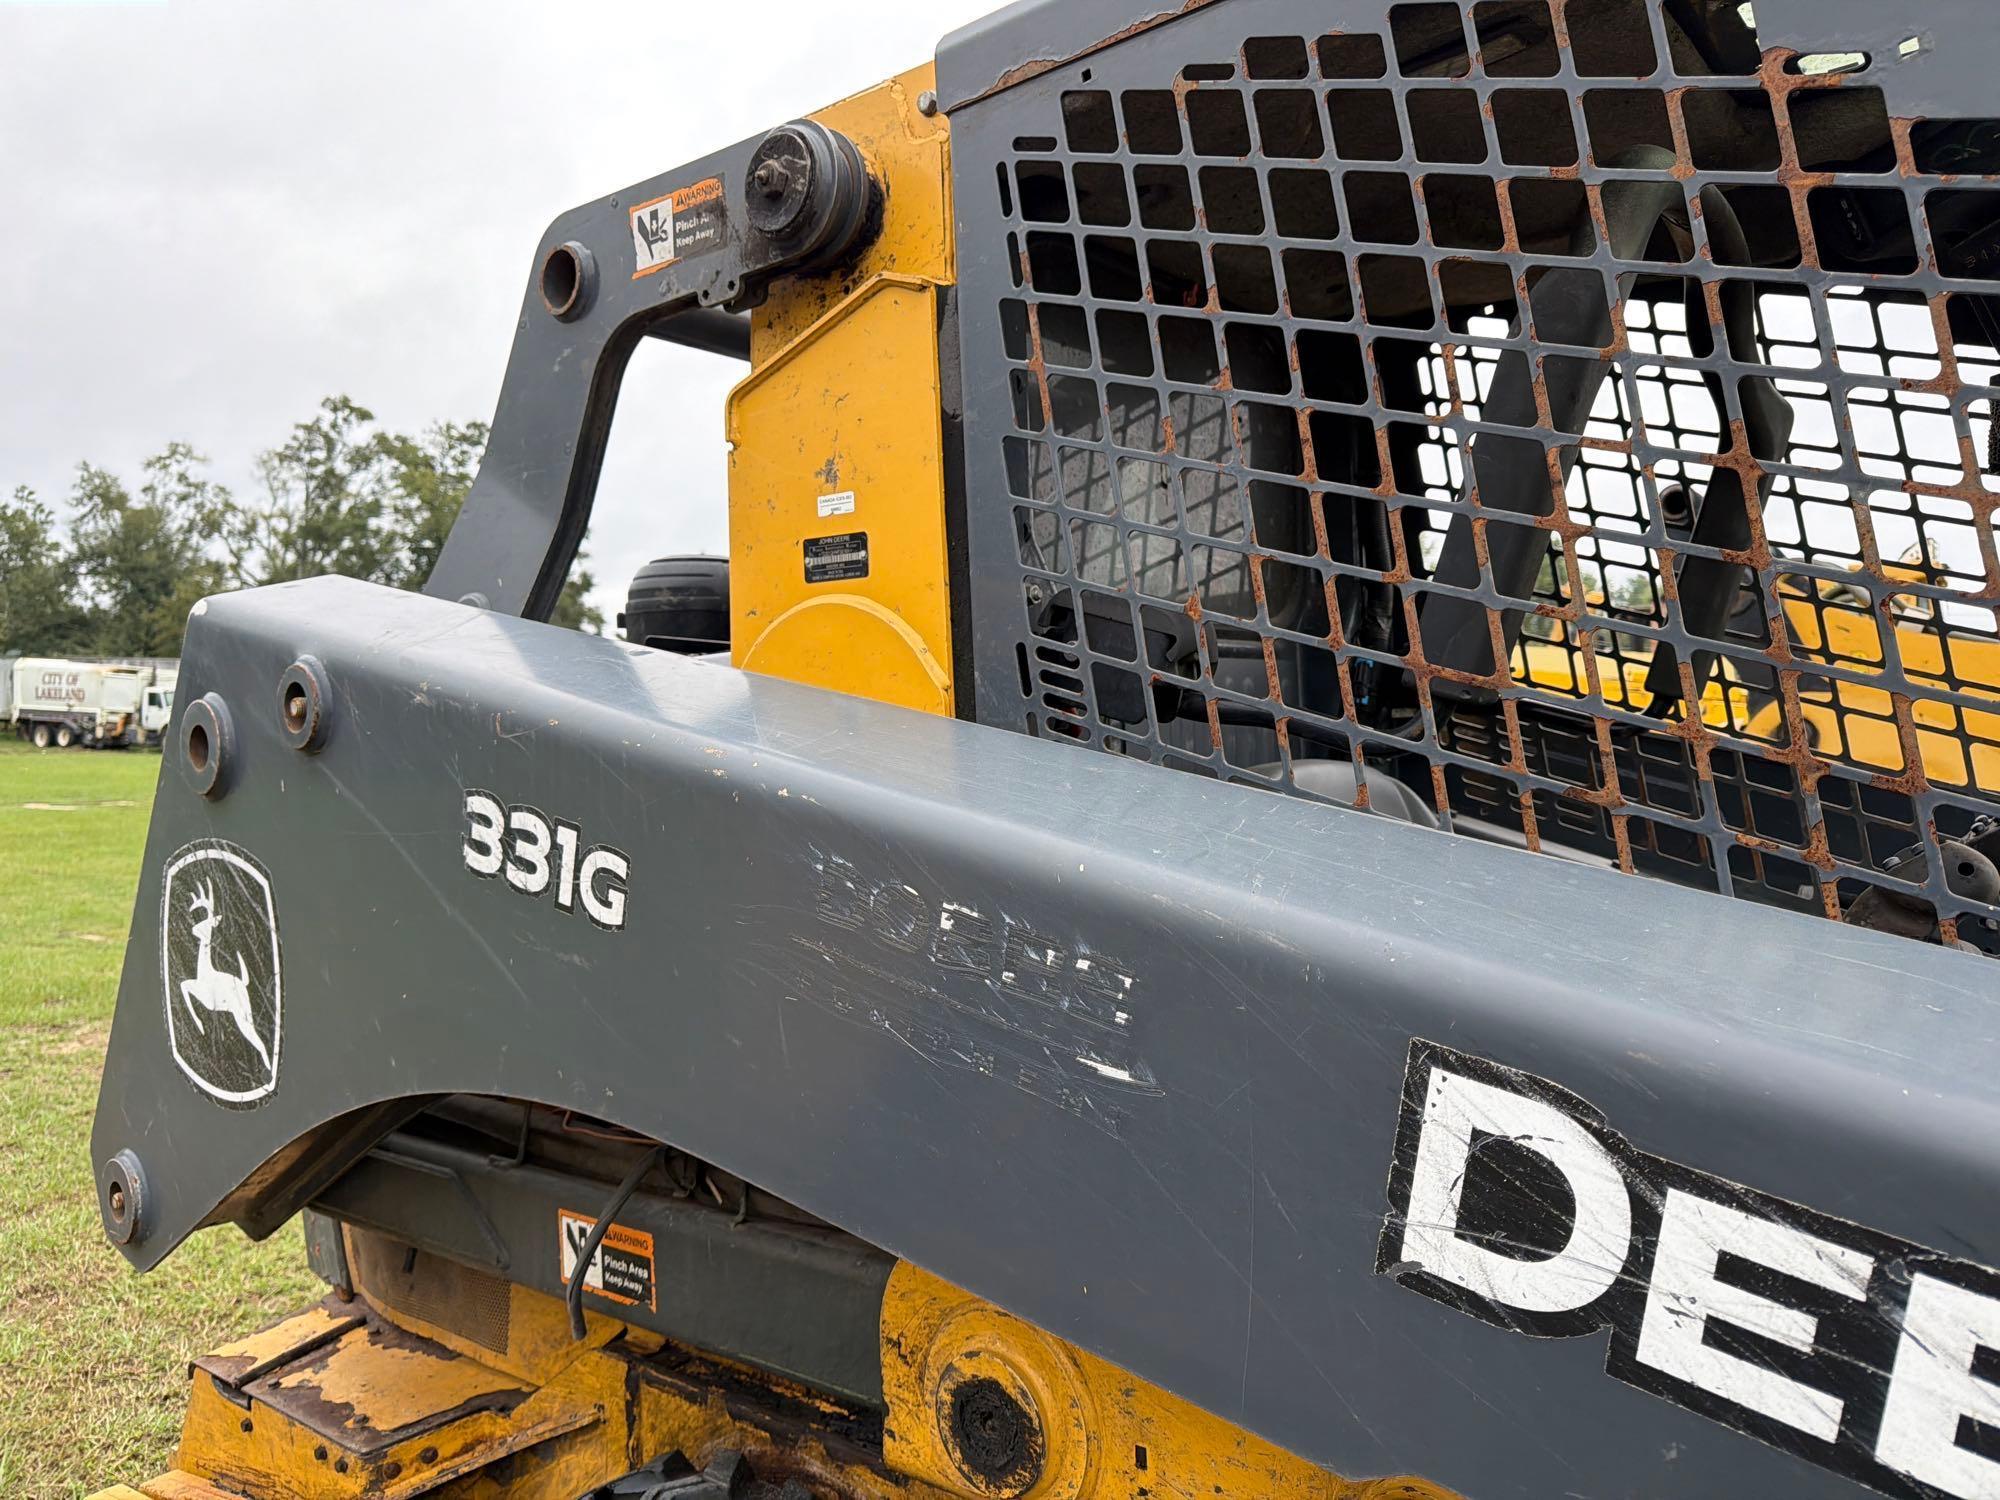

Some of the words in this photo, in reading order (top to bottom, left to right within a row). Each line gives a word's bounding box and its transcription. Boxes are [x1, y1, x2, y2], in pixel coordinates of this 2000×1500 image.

[684, 181, 721, 203] WARNING
[675, 216, 699, 233] Pinch
[676, 234, 694, 248] Keep
[695, 228, 715, 241] Away
[42, 672, 63, 685] CITY
[66, 672, 80, 685] OF
[35, 686, 86, 702] LAKELAND
[464, 795, 628, 926] 331G
[612, 1231, 649, 1251] WARNING
[604, 1254, 628, 1272] Pinch
[628, 1264, 648, 1279] Area
[604, 1272, 622, 1288] Keep
[623, 1276, 643, 1294] Away
